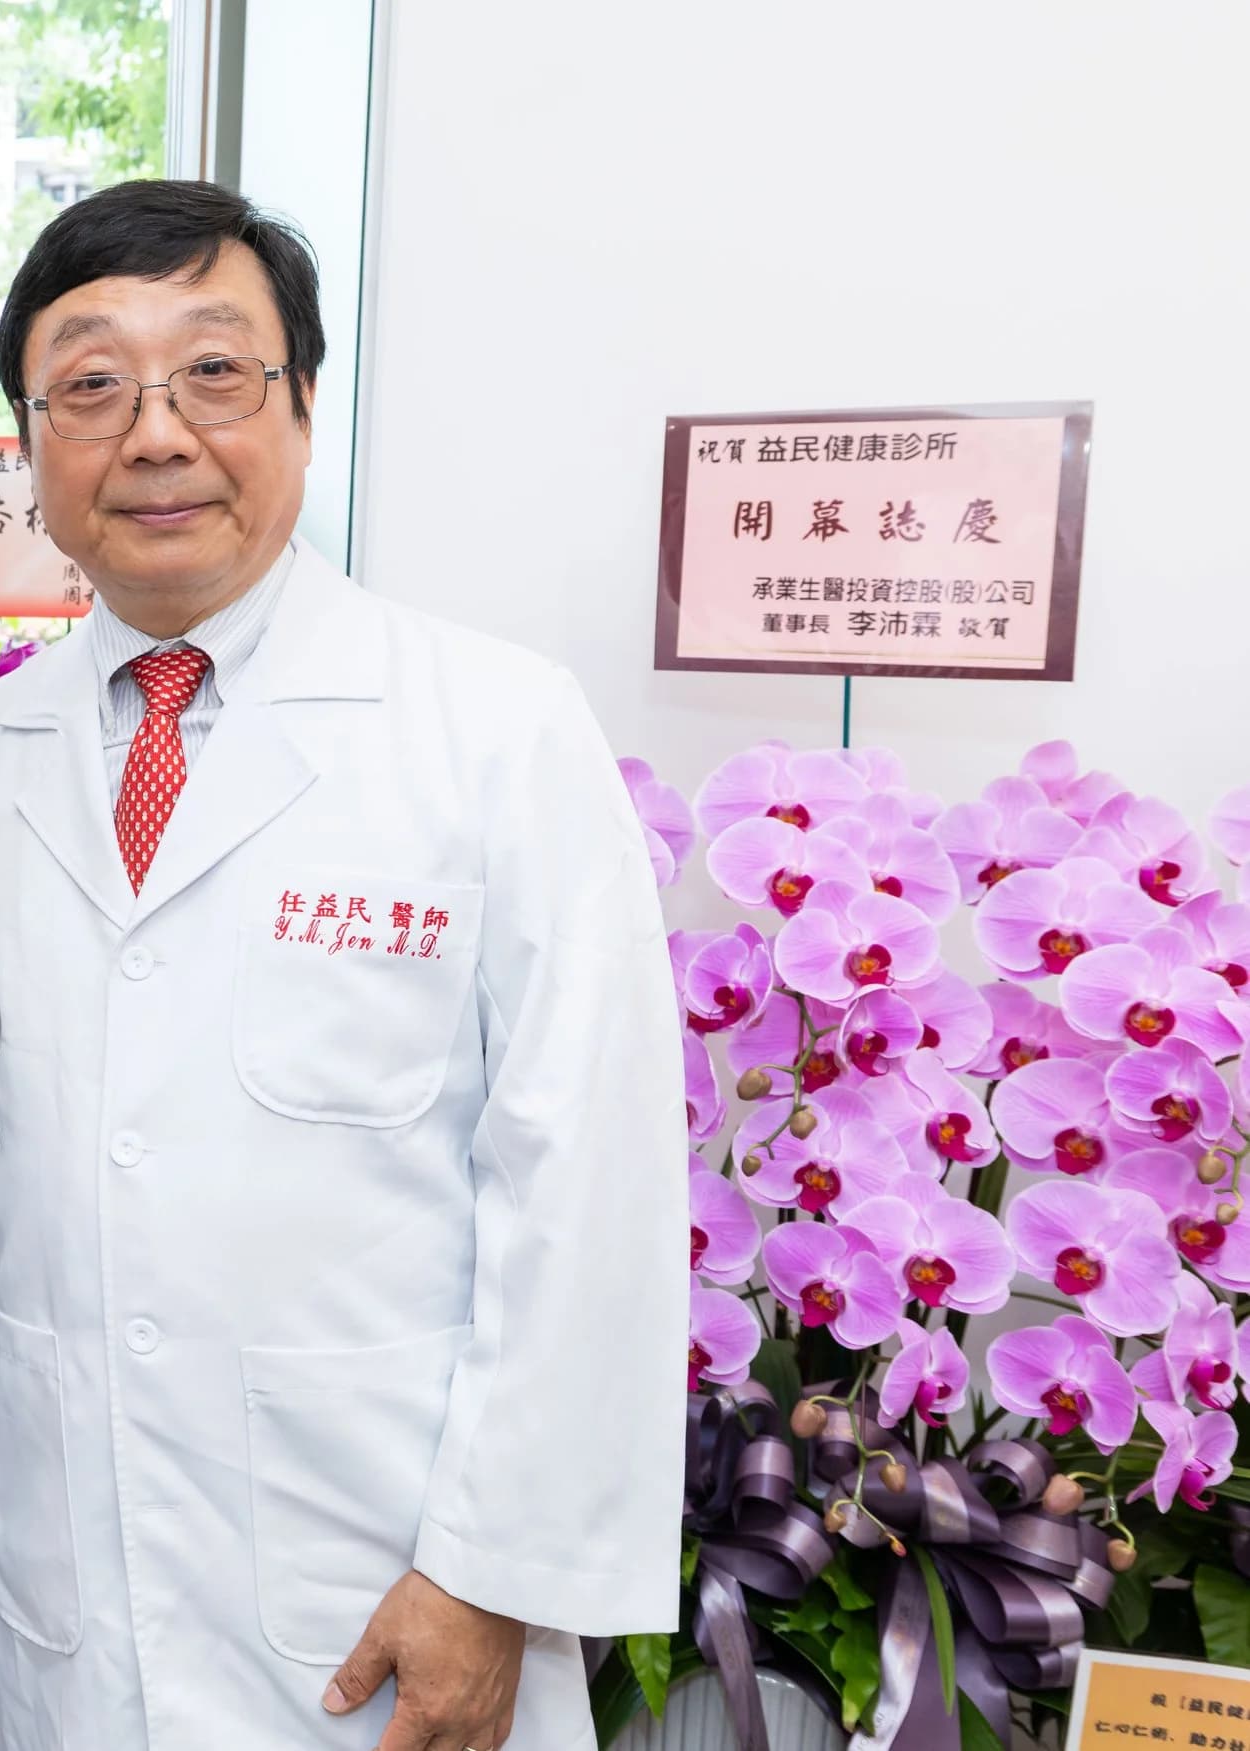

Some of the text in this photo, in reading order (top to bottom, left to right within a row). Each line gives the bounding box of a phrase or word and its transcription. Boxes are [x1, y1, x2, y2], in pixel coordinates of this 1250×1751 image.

[697, 431, 958, 465] 祝賀 益民健康診所
[732, 497, 1002, 545] 開幕誌慶
[752, 576, 1035, 606] 承業生醫投資控股(股)公司
[762, 612, 831, 635] 董事長
[847, 609, 942, 638] 李沛霖
[277, 889, 450, 934] 任益民 醫師
